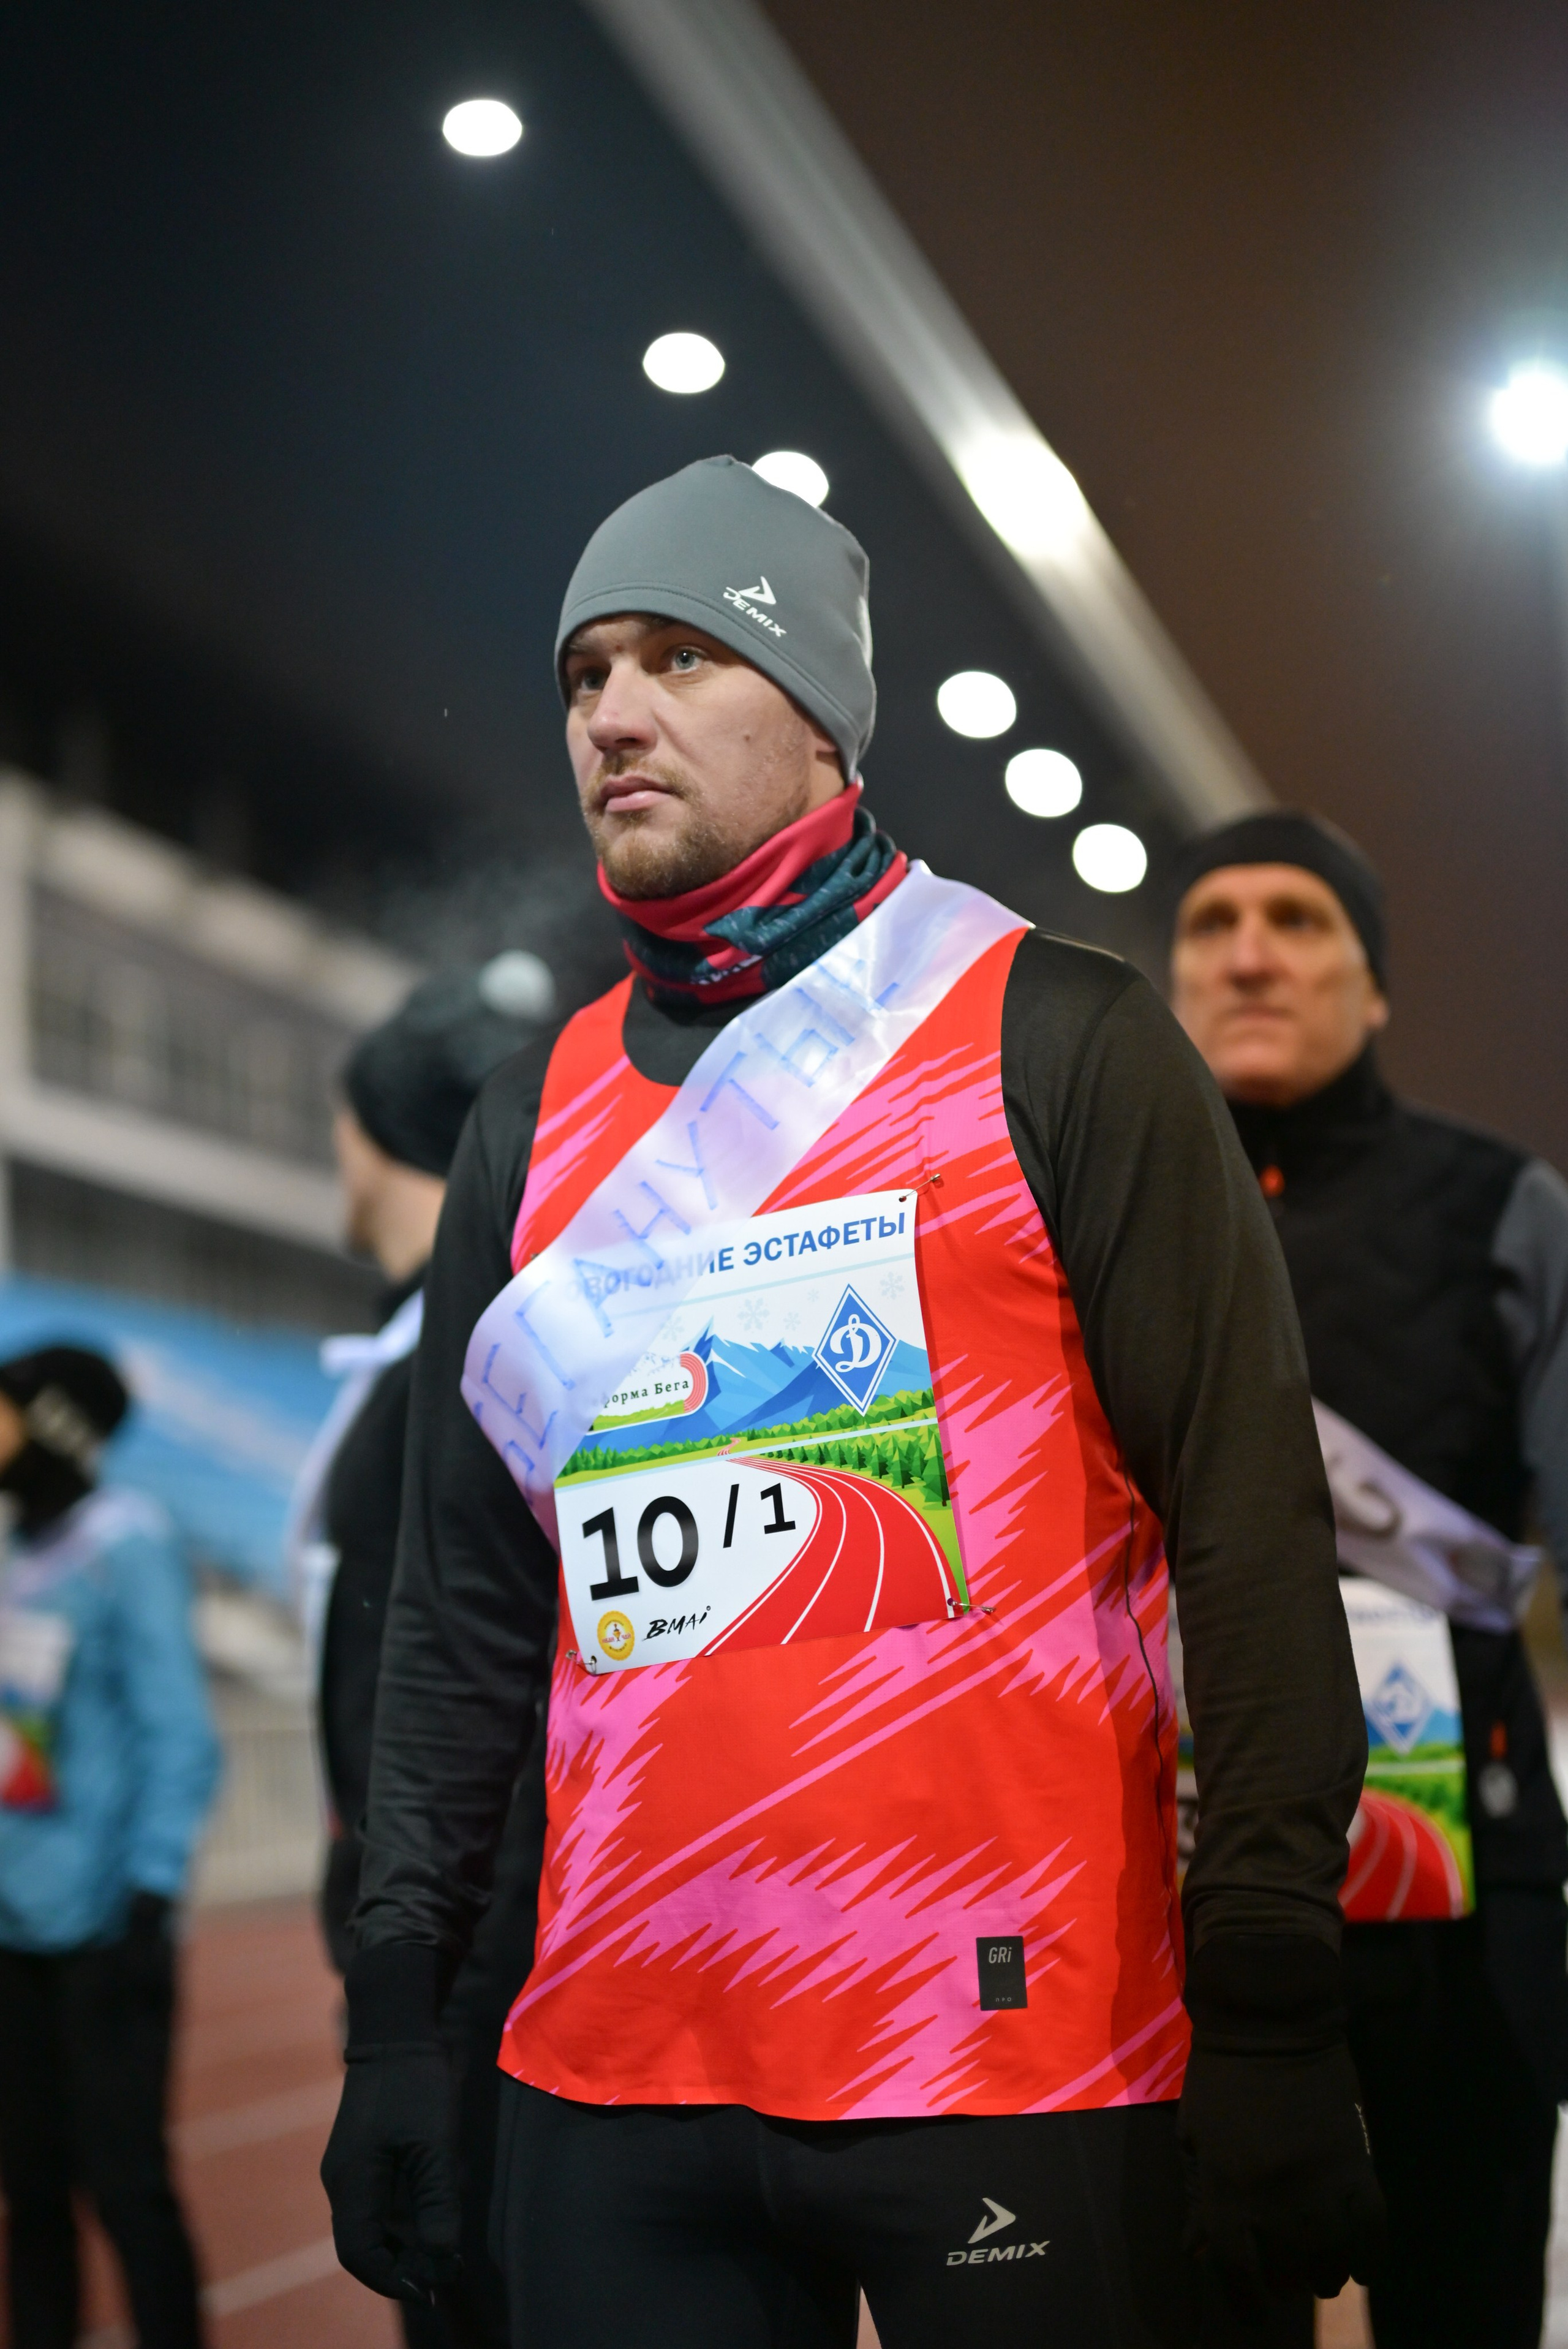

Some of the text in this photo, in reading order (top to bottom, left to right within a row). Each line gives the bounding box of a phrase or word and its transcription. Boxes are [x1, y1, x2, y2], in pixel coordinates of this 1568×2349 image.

[723, 586, 787, 637] DEMIX
[743, 1212, 905, 1266] ЭСТАФЕТЫ
[655, 1379, 689, 1394] Бега
[946, 2240, 1050, 2266] DEMIX
